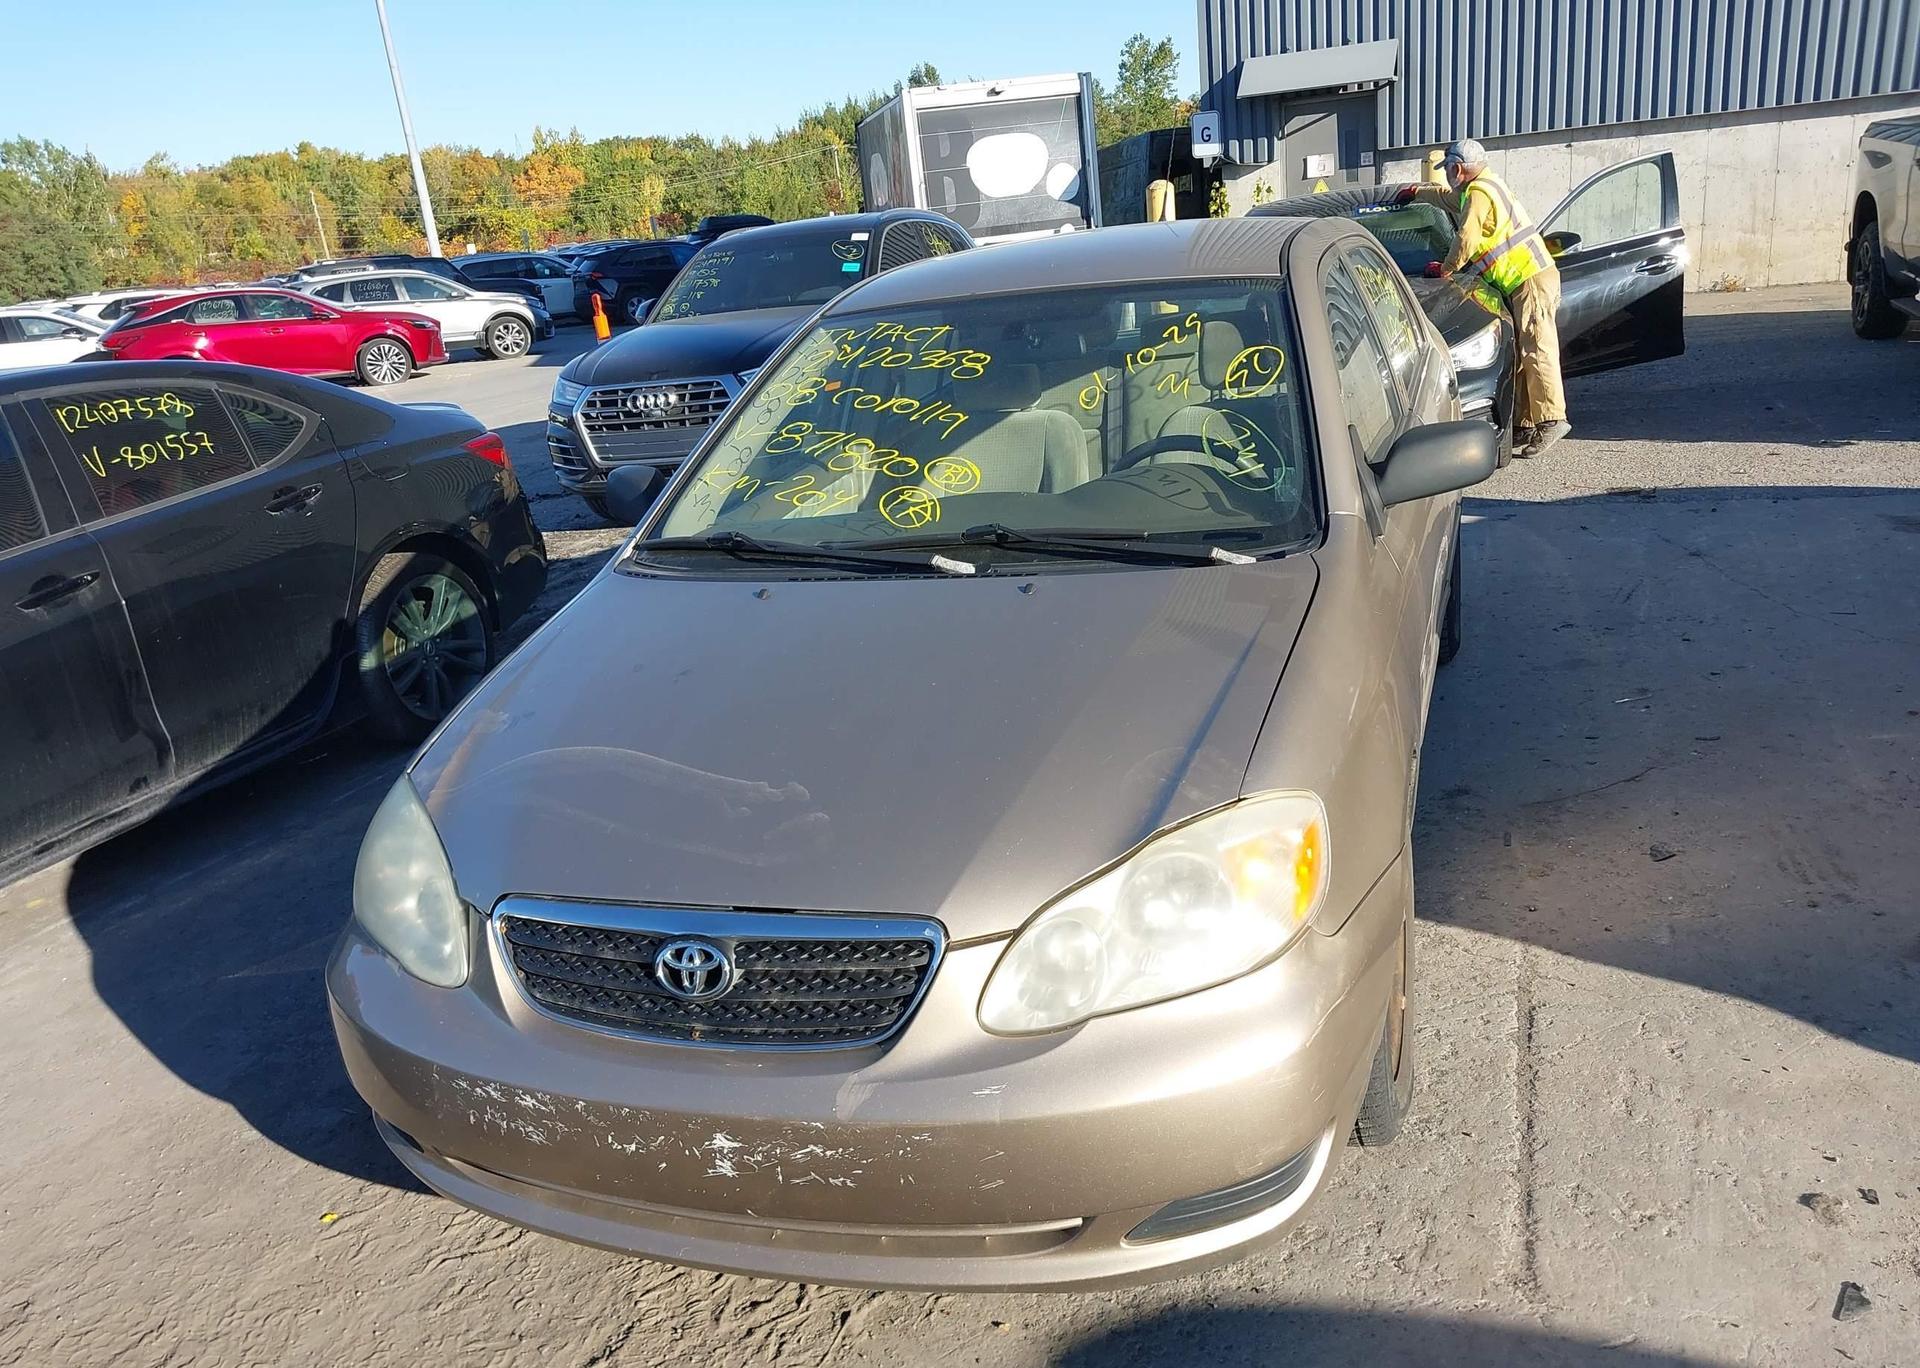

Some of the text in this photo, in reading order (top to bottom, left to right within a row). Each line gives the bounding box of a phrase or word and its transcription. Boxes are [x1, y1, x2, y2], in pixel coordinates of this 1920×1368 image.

[1201, 126, 1212, 143] G
[1358, 204, 1400, 213] FLOOD
[812, 321, 953, 350] INTACT
[83, 431, 215, 478] V-801557
